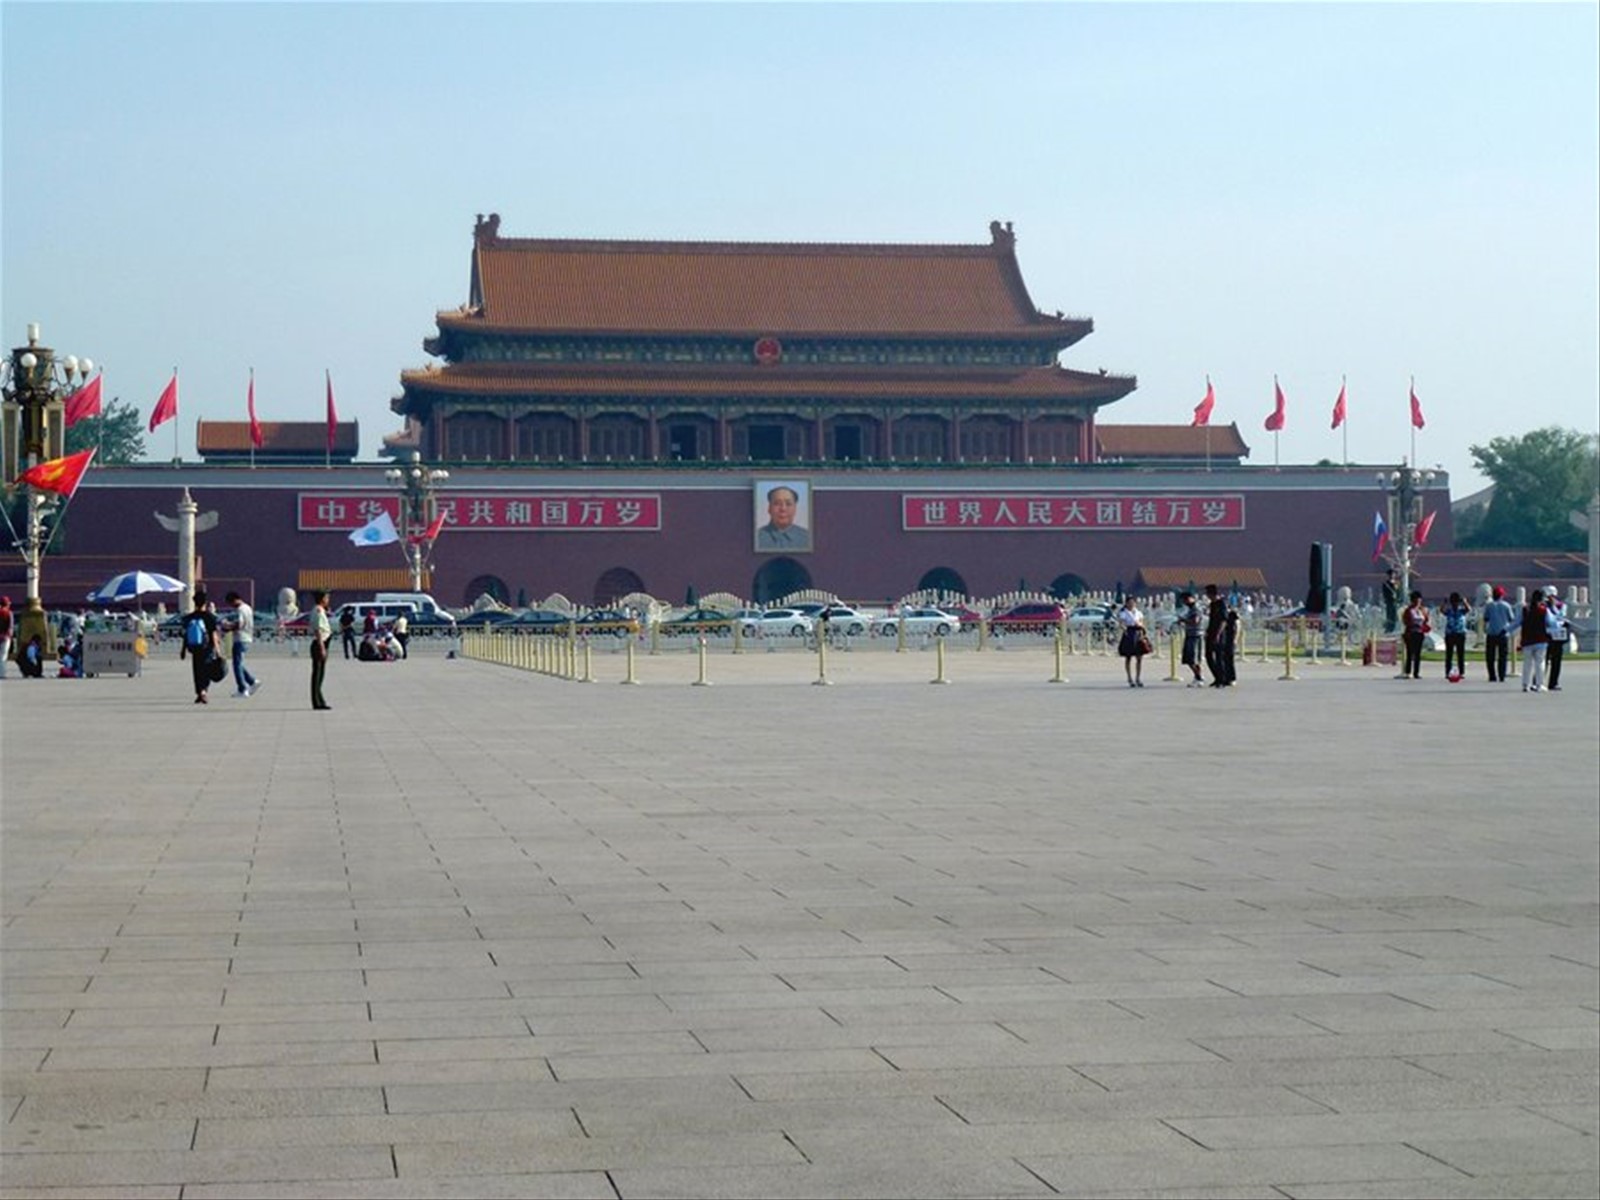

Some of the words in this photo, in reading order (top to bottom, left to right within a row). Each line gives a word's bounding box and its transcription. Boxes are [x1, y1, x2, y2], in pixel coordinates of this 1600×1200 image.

[318, 500, 642, 525] 中华民共和国万岁
[922, 500, 1227, 525] 世界人民大团结万岁
